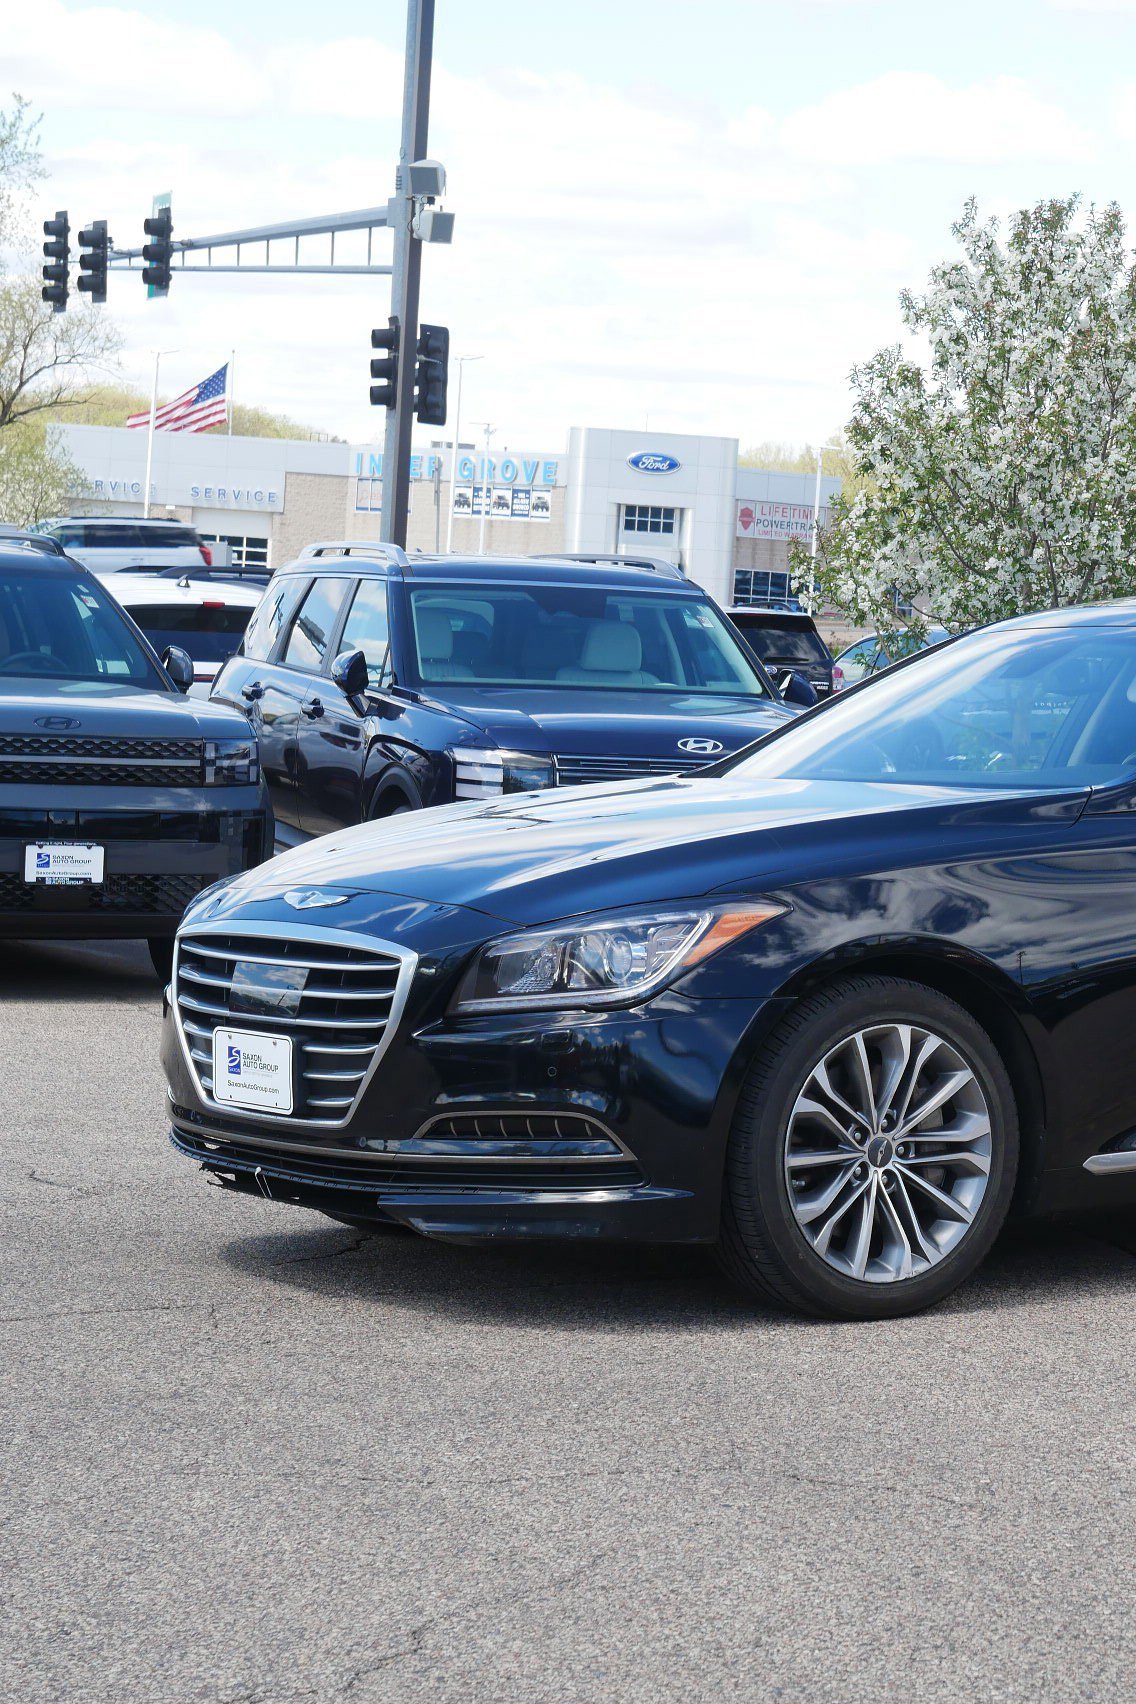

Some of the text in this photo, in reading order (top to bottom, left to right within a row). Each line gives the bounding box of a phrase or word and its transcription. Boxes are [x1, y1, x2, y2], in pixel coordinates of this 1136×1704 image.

[356, 452, 558, 485] INER GROVE
[191, 486, 277, 503] SERVICE
[760, 505, 813, 520] LIFETIM
[756, 518, 814, 532] POWERTRA
[784, 532, 813, 540] WARRAN
[242, 1052, 263, 1063] SAXON
[242, 1060, 279, 1073] AUTO GROUP
[227, 1079, 280, 1094] SaxonAutoGroup.com
